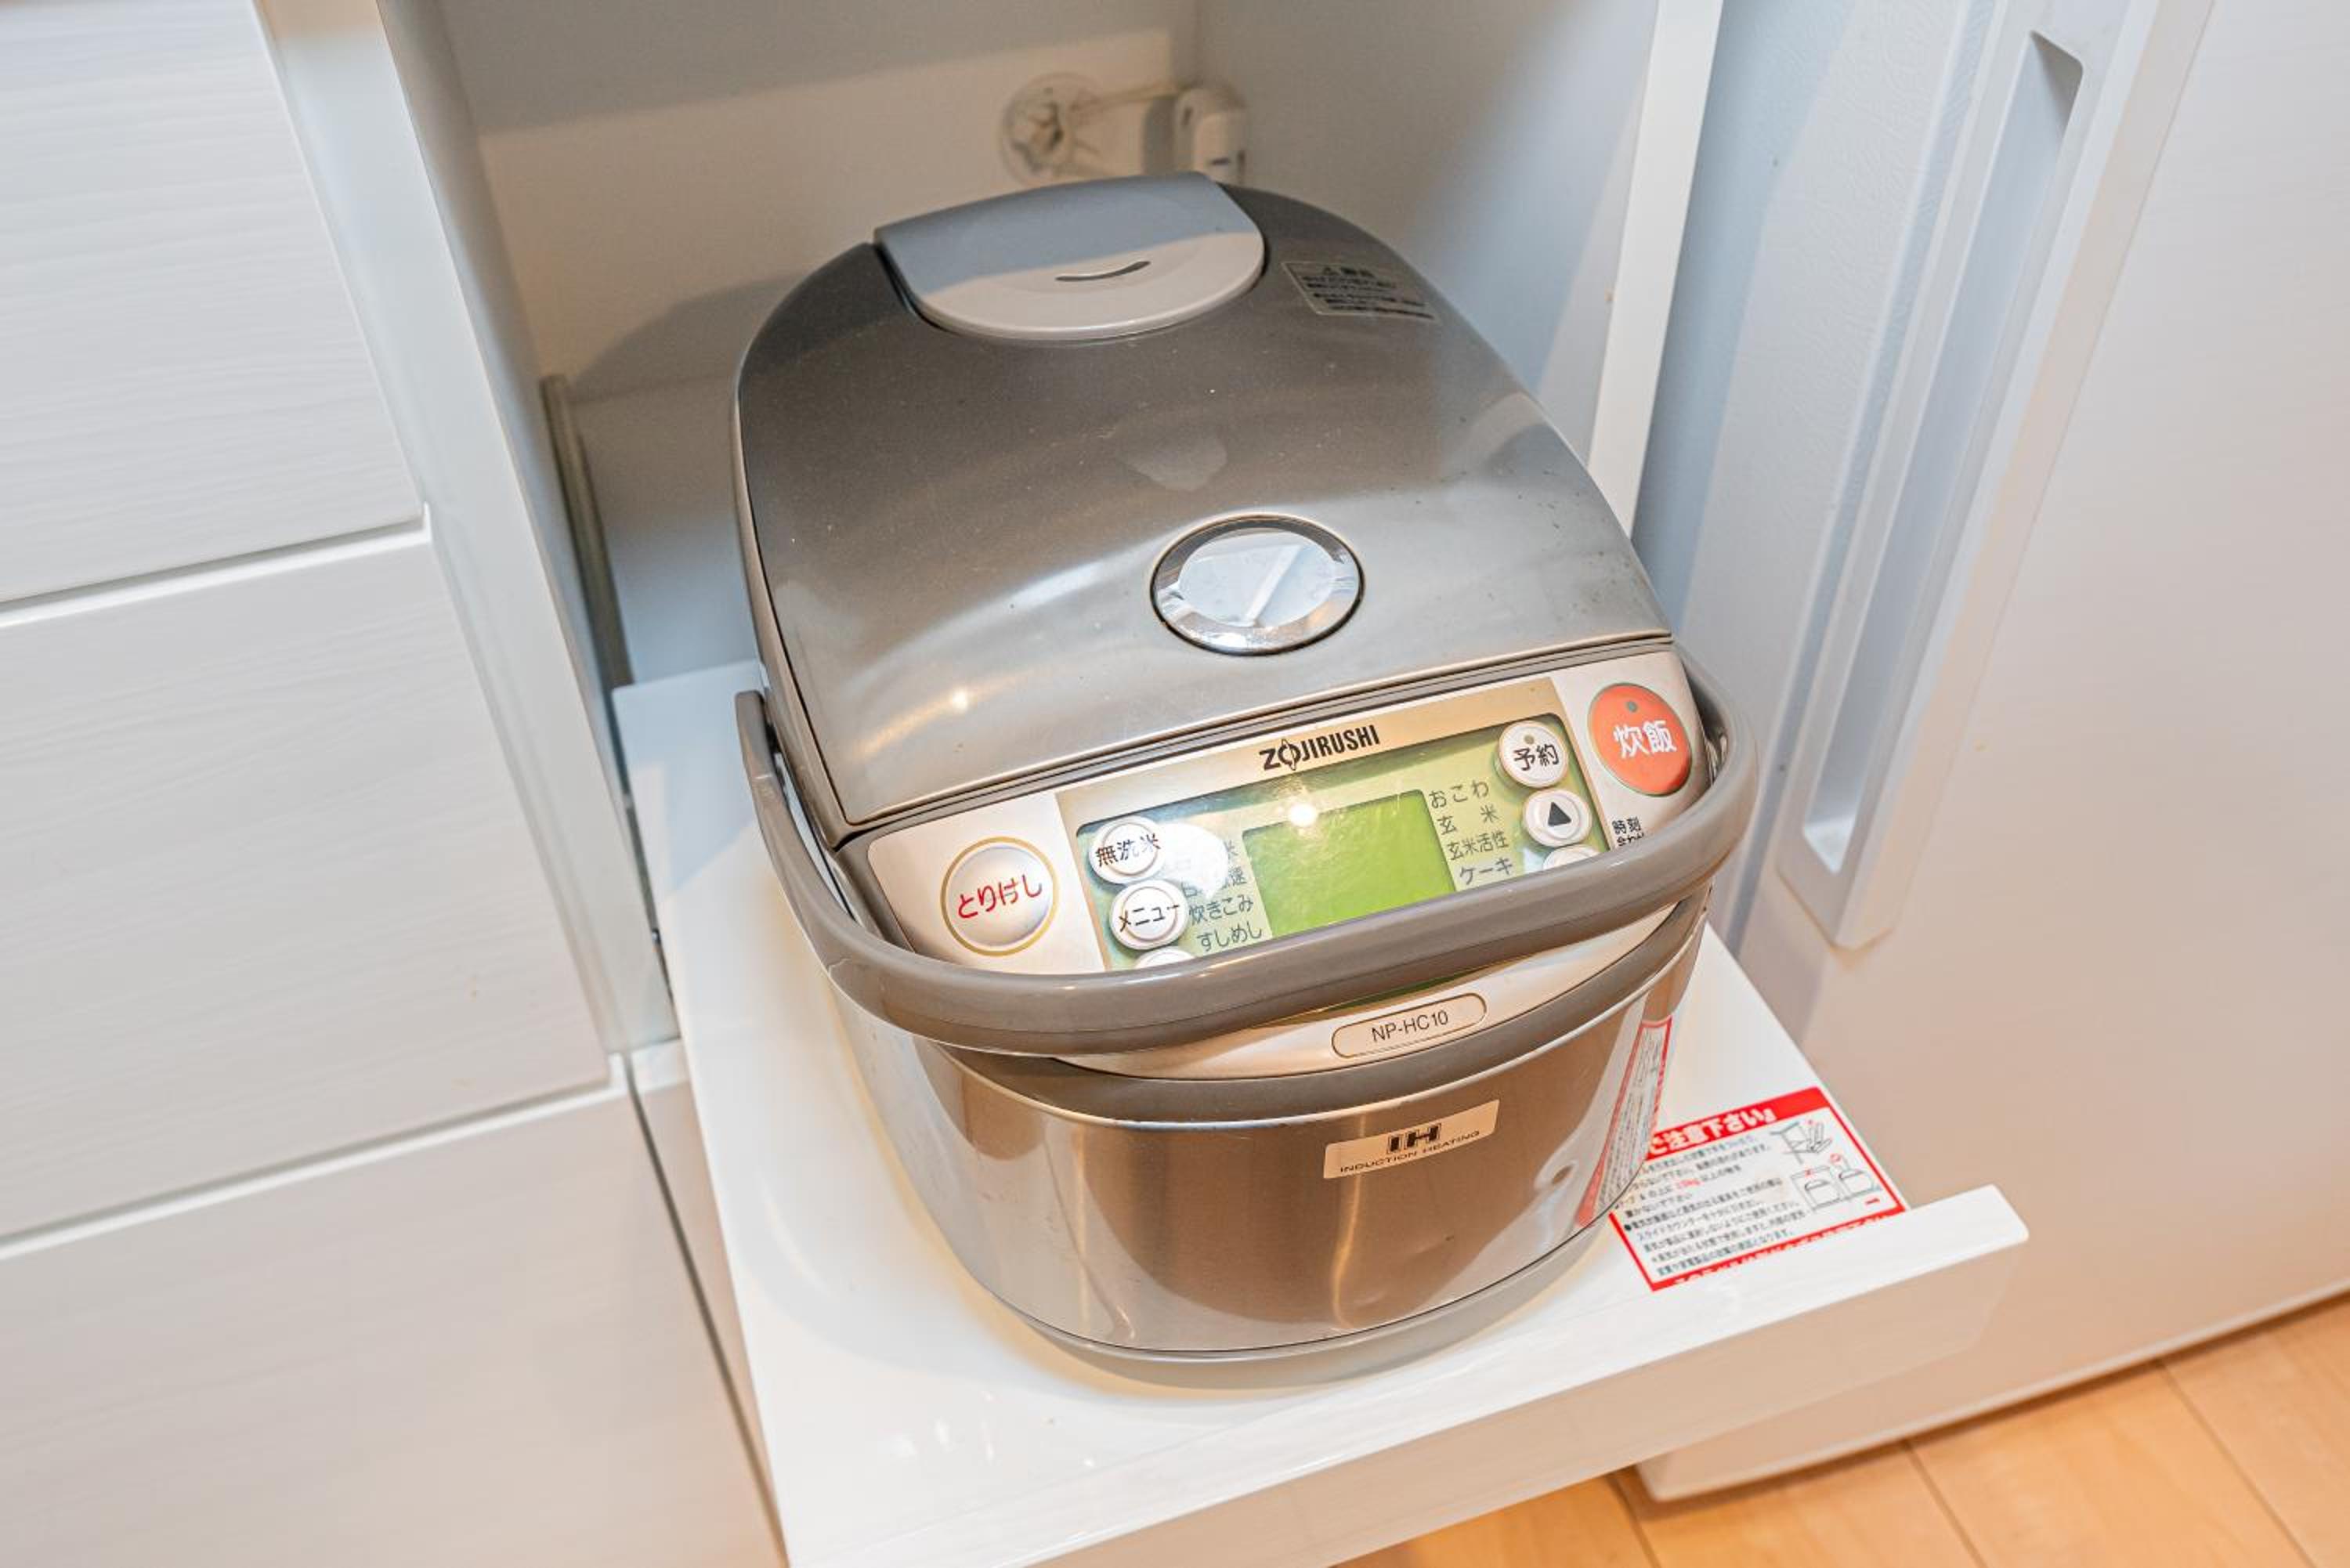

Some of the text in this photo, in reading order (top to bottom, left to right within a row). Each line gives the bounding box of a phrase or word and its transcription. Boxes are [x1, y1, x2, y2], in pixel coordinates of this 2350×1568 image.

[1259, 724, 1380, 771] ZOJIRUSHI
[1613, 719, 1677, 760] 炊飯
[1513, 743, 1560, 771] 予約
[1430, 780, 1489, 809] おこわ
[1095, 833, 1161, 867] 無洗米
[1447, 829, 1510, 862] 玄米活性
[1459, 853, 1513, 885] ケーキ
[956, 873, 1043, 919] とりけし
[1189, 894, 1253, 926] 炊きこみ
[1118, 903, 1180, 932] メニュー
[1197, 921, 1262, 952] すしめし
[1372, 1009, 1448, 1043] NP-HC10
[1340, 1130, 1480, 1173] INDUCTION HEATING
[1386, 1122, 1441, 1154] IH
